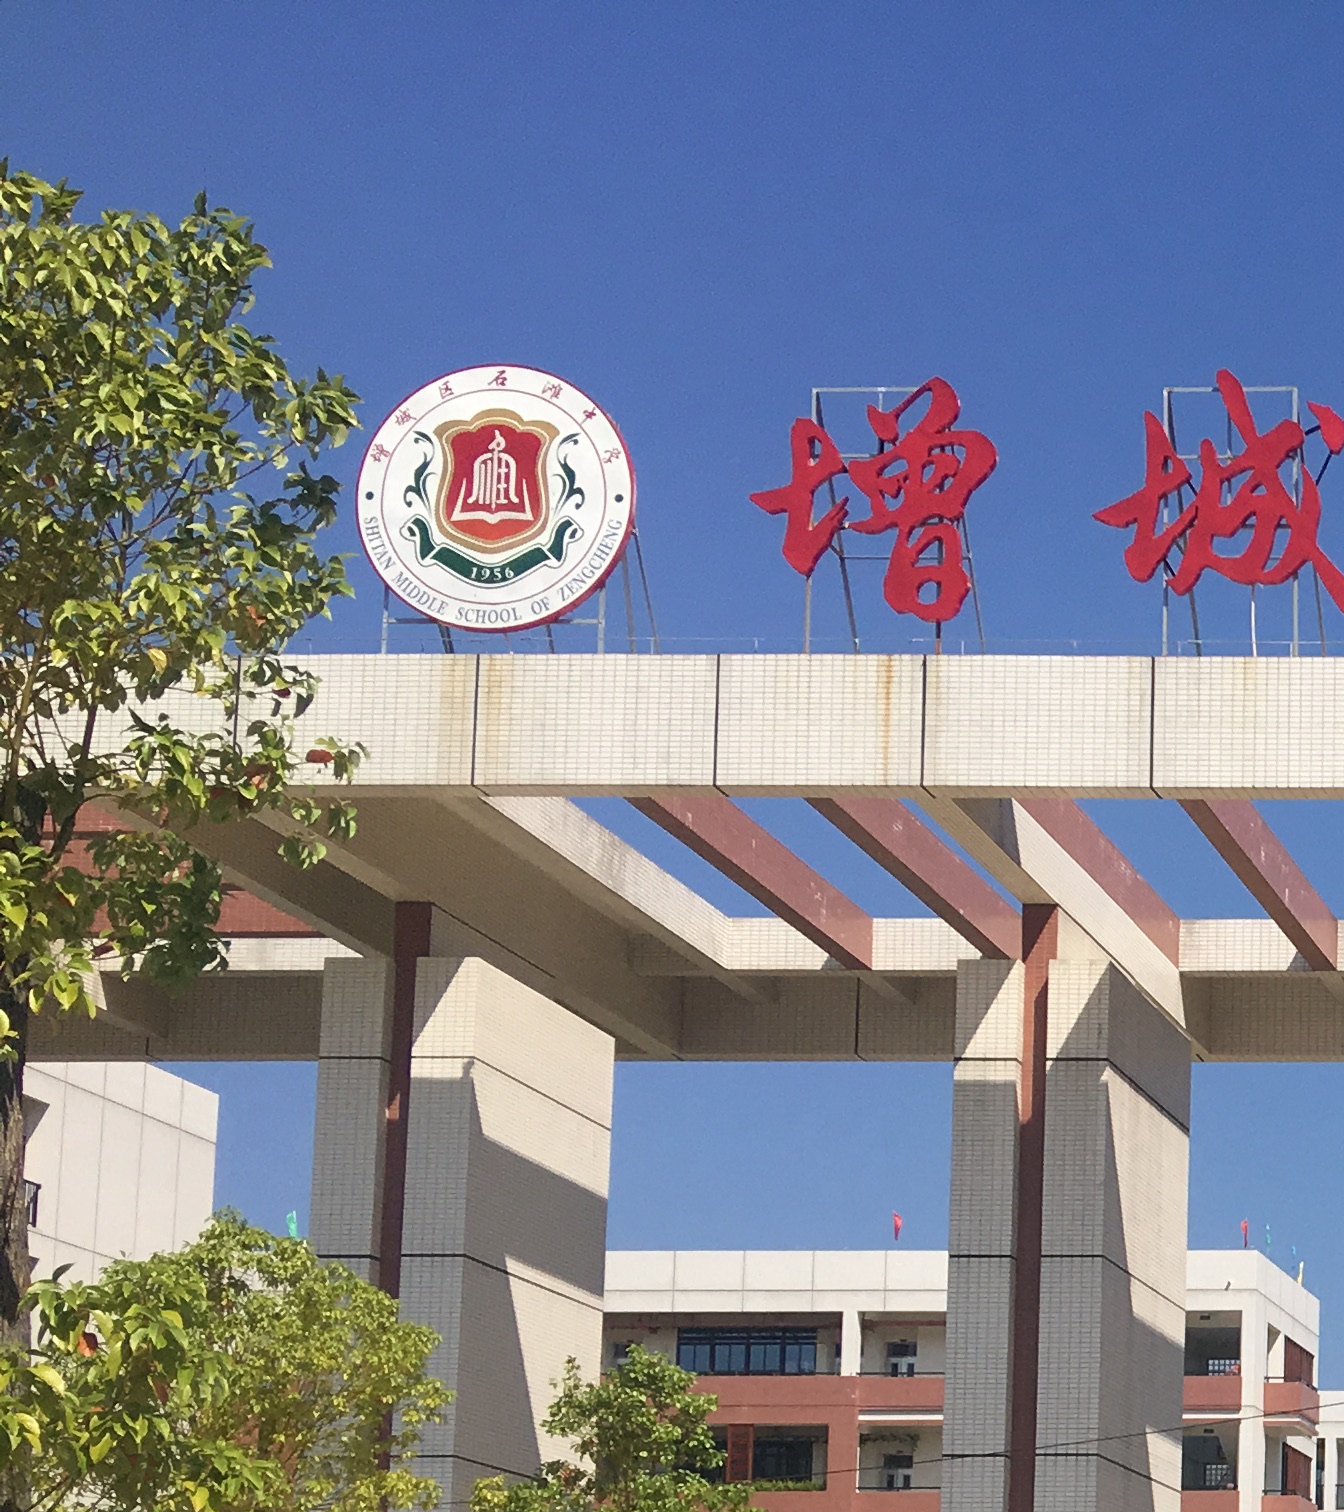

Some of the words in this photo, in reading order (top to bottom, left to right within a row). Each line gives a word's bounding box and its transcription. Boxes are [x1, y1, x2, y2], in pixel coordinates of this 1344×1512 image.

[364, 516, 396, 571] SHITAN
[391, 571, 449, 615] MIDDLE
[455, 606, 522, 624] SCHOOL
[531, 596, 552, 615] OF
[556, 519, 623, 602] ZENGCHENG
[470, 566, 514, 580] 1956
